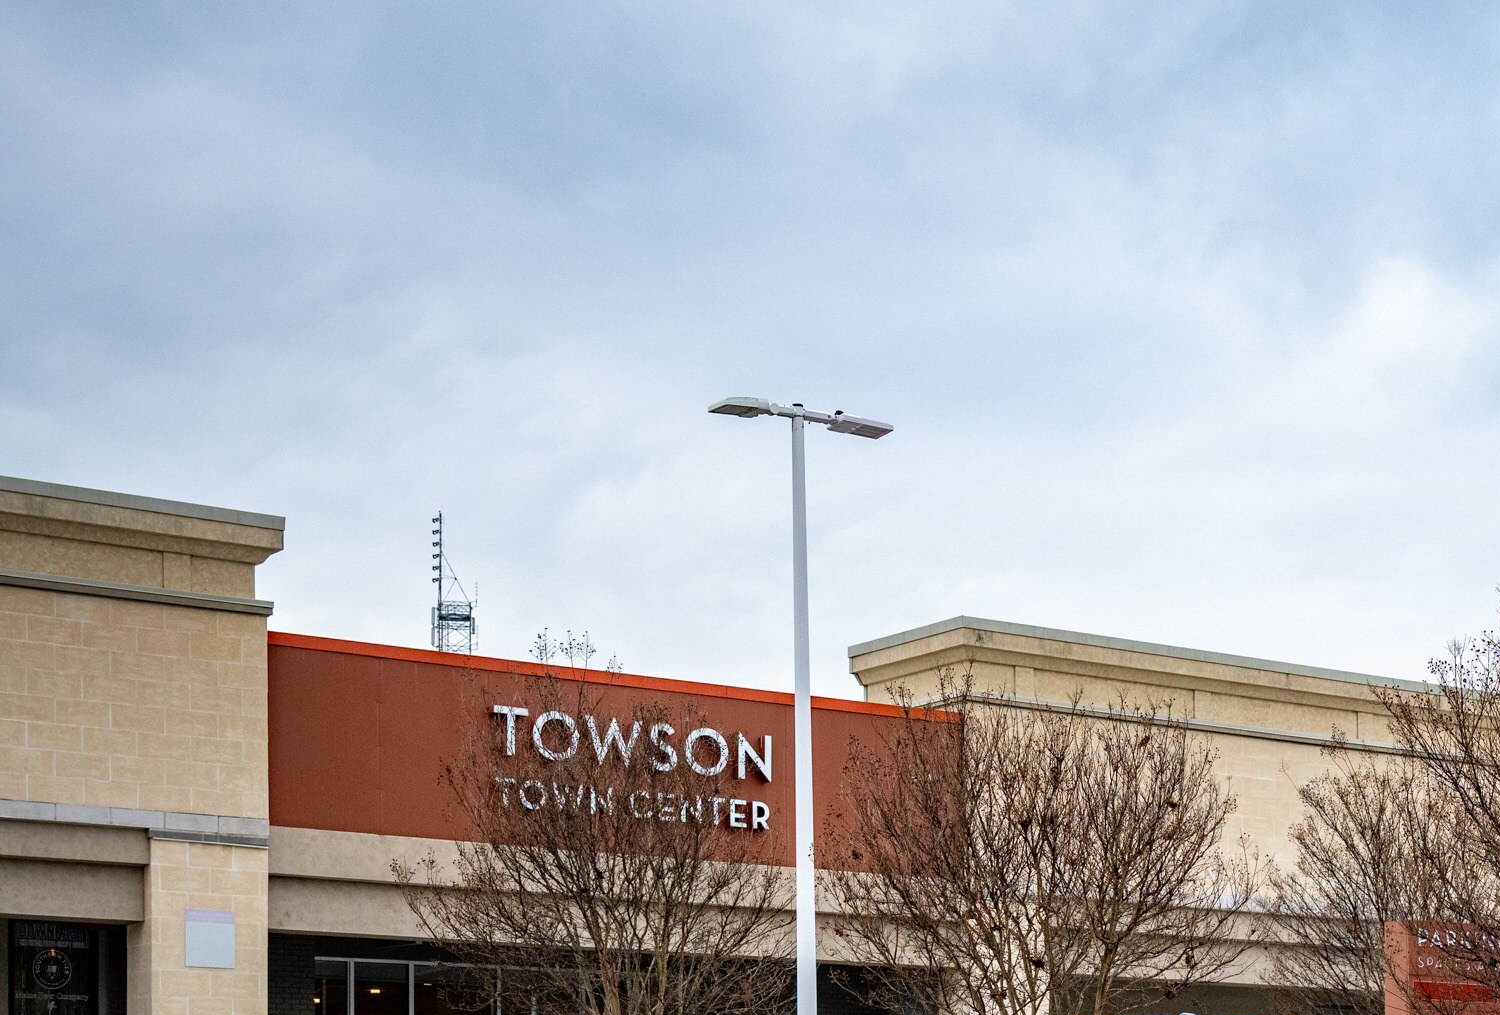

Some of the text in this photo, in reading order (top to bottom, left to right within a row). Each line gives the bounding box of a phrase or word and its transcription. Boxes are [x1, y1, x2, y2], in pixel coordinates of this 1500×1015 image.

[492, 704, 774, 783] TOWSON
[495, 776, 771, 831] TOWN CENTER
